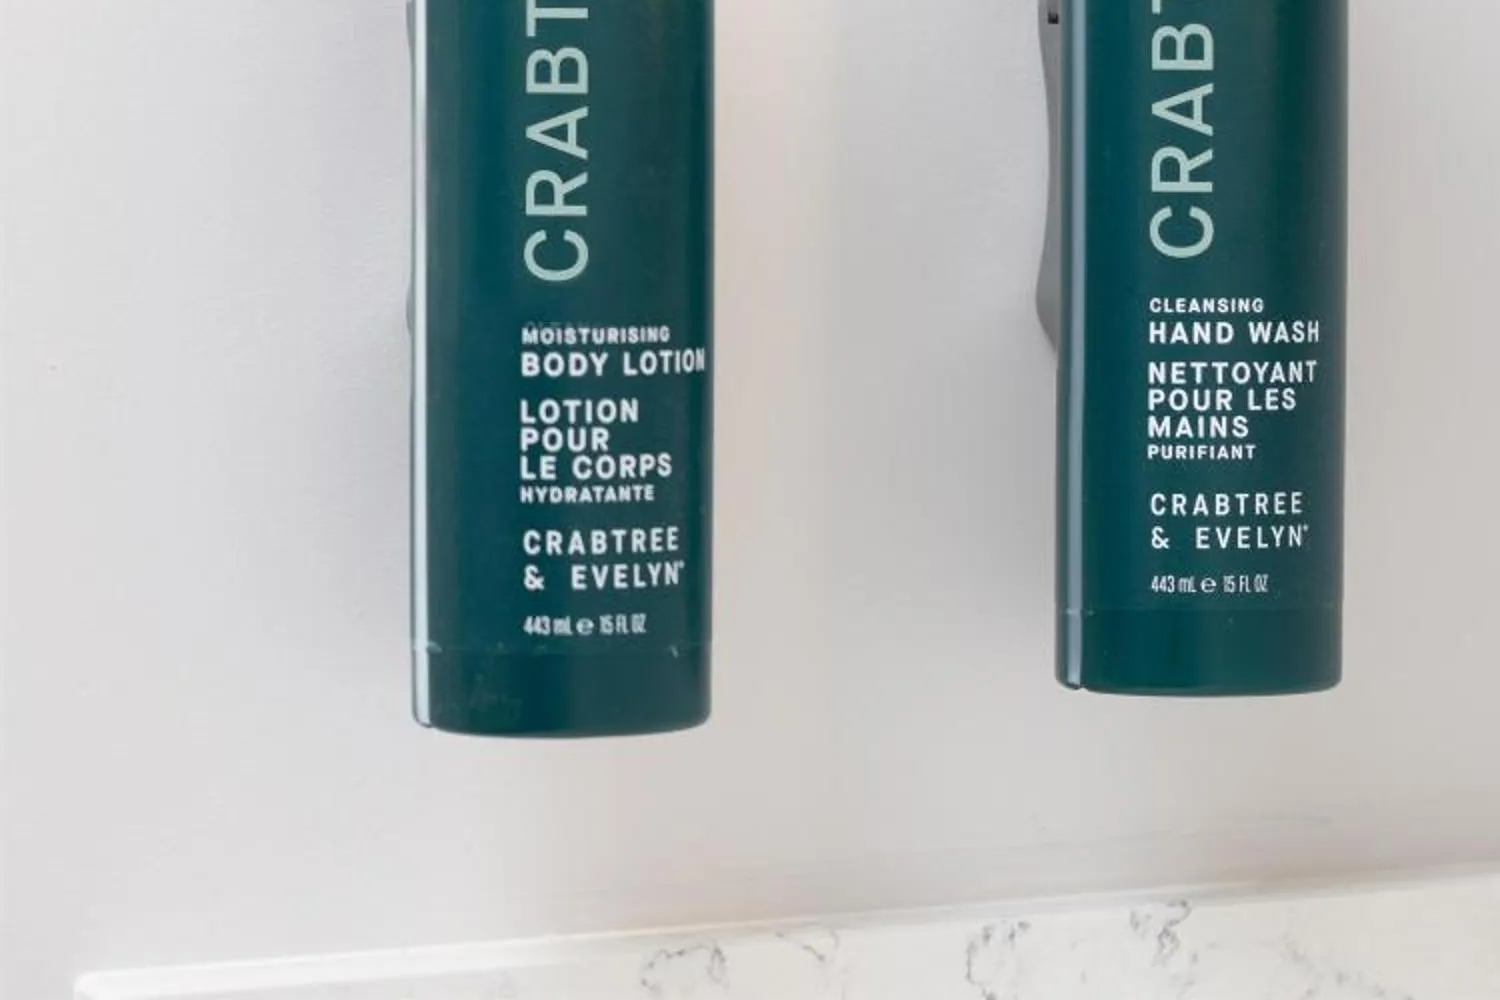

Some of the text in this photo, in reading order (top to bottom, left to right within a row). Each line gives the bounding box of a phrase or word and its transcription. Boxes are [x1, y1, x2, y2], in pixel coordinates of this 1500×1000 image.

[1149, 297, 1264, 313] CLEANSING
[521, 326, 670, 345] MOISTURISING
[1149, 320, 1319, 345] HAND WASH
[521, 348, 705, 377] BODY LOTION
[1148, 360, 1317, 385] NETTOYANT
[520, 398, 638, 424] LOTION
[1148, 387, 1296, 412] POUR LES
[1148, 415, 1249, 438] MAINS
[520, 427, 610, 452] POUR
[1147, 444, 1256, 460] PURIFIANT
[520, 452, 672, 480] LE CORPS
[520, 484, 654, 503] HYDRATANTE
[1150, 491, 1303, 516] CRABTREE
[523, 526, 679, 555] CRABTREE
[1151, 526, 1170, 549] &
[524, 565, 544, 590] &
[1151, 575, 1175, 593] 443
[1223, 575, 1236, 593] 15
[1239, 575, 1251, 593] FL
[523, 615, 551, 636] 443
[600, 615, 613, 634] 15
